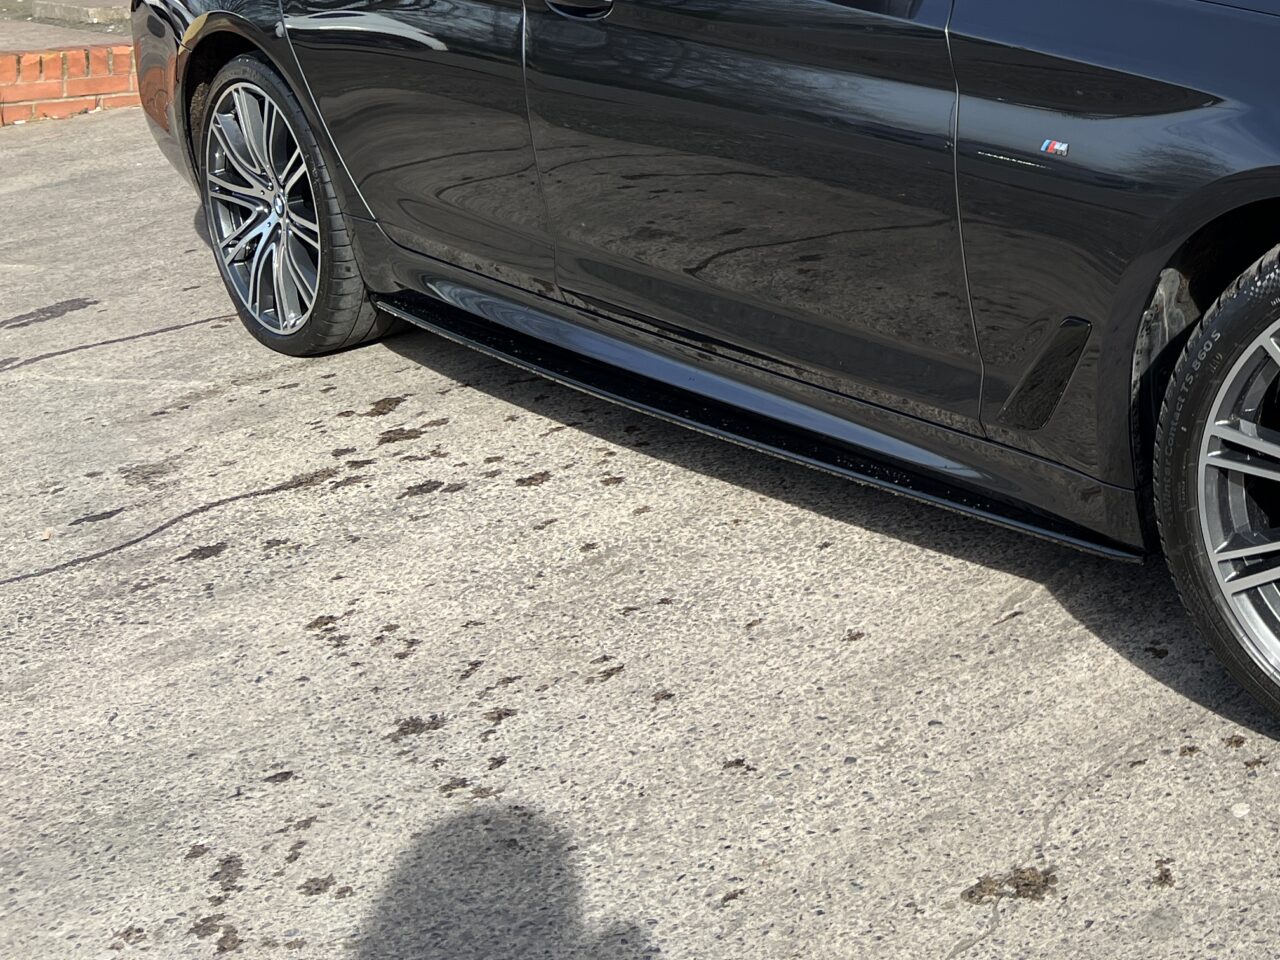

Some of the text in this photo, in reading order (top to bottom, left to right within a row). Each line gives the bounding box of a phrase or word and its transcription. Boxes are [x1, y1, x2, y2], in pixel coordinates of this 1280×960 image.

[1180, 373, 1195, 393] TS
[1191, 340, 1213, 372] 860
[1211, 329, 1221, 342] S
